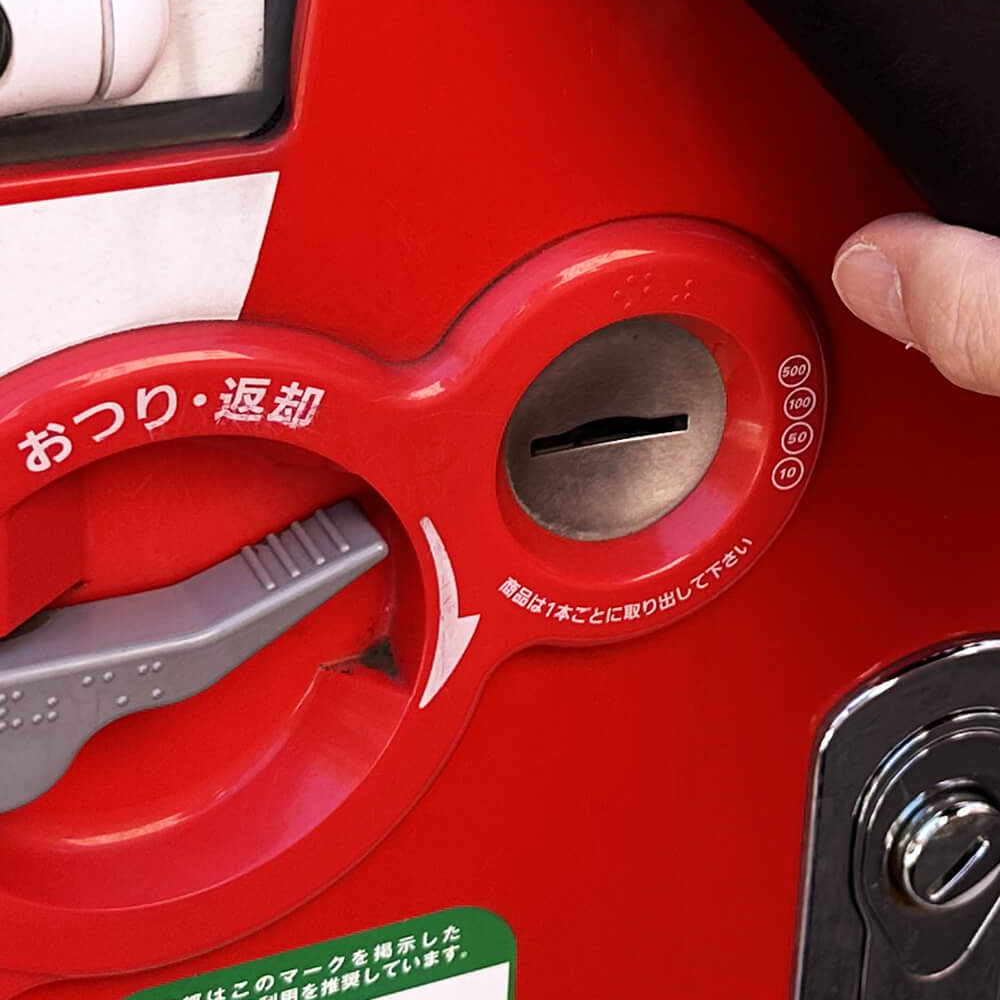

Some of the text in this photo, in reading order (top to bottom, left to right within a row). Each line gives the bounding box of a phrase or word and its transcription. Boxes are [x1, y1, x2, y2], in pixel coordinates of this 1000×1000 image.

[782, 364, 806, 378] 500
[789, 396, 811, 410] 100
[17, 376, 325, 472] おつり・返却
[787, 431, 807, 444] 50
[780, 466, 797, 480] 10
[498, 537, 753, 625] 商品は1本ごとに取り出して下さい
